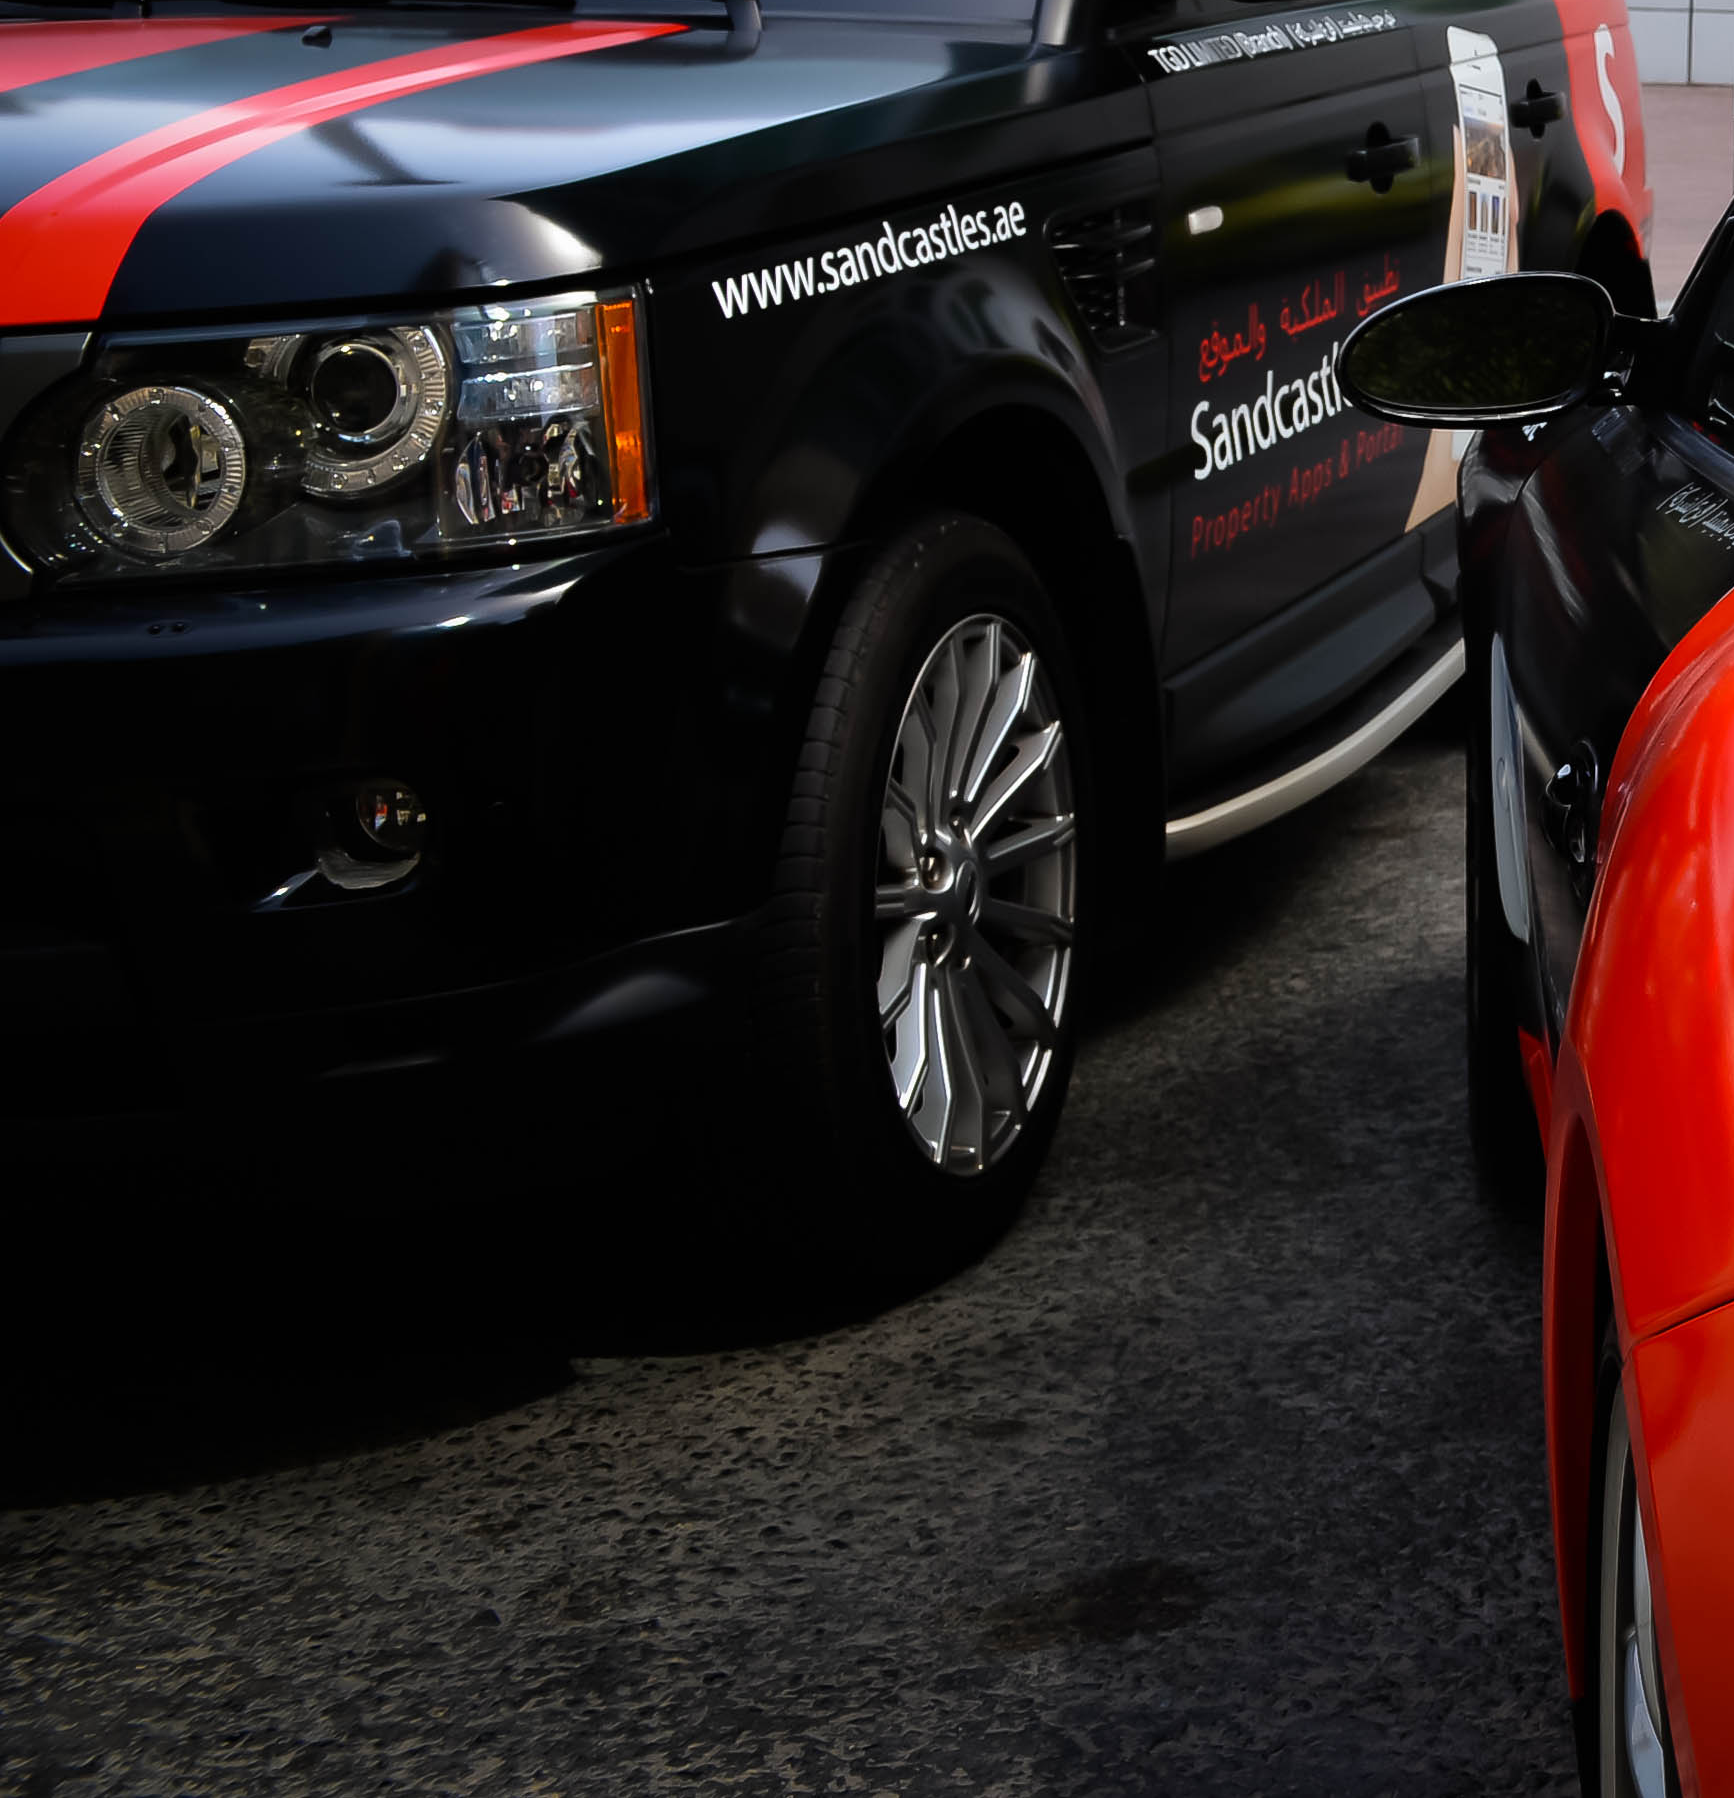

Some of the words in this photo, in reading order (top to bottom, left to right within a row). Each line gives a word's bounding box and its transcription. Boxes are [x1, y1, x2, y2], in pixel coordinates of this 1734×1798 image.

[712, 201, 1027, 319] www.sandcastles.ae
[1191, 341, 1353, 480] Sandcastl
[1192, 484, 1281, 558] Property
[1289, 458, 1333, 508] Apps
